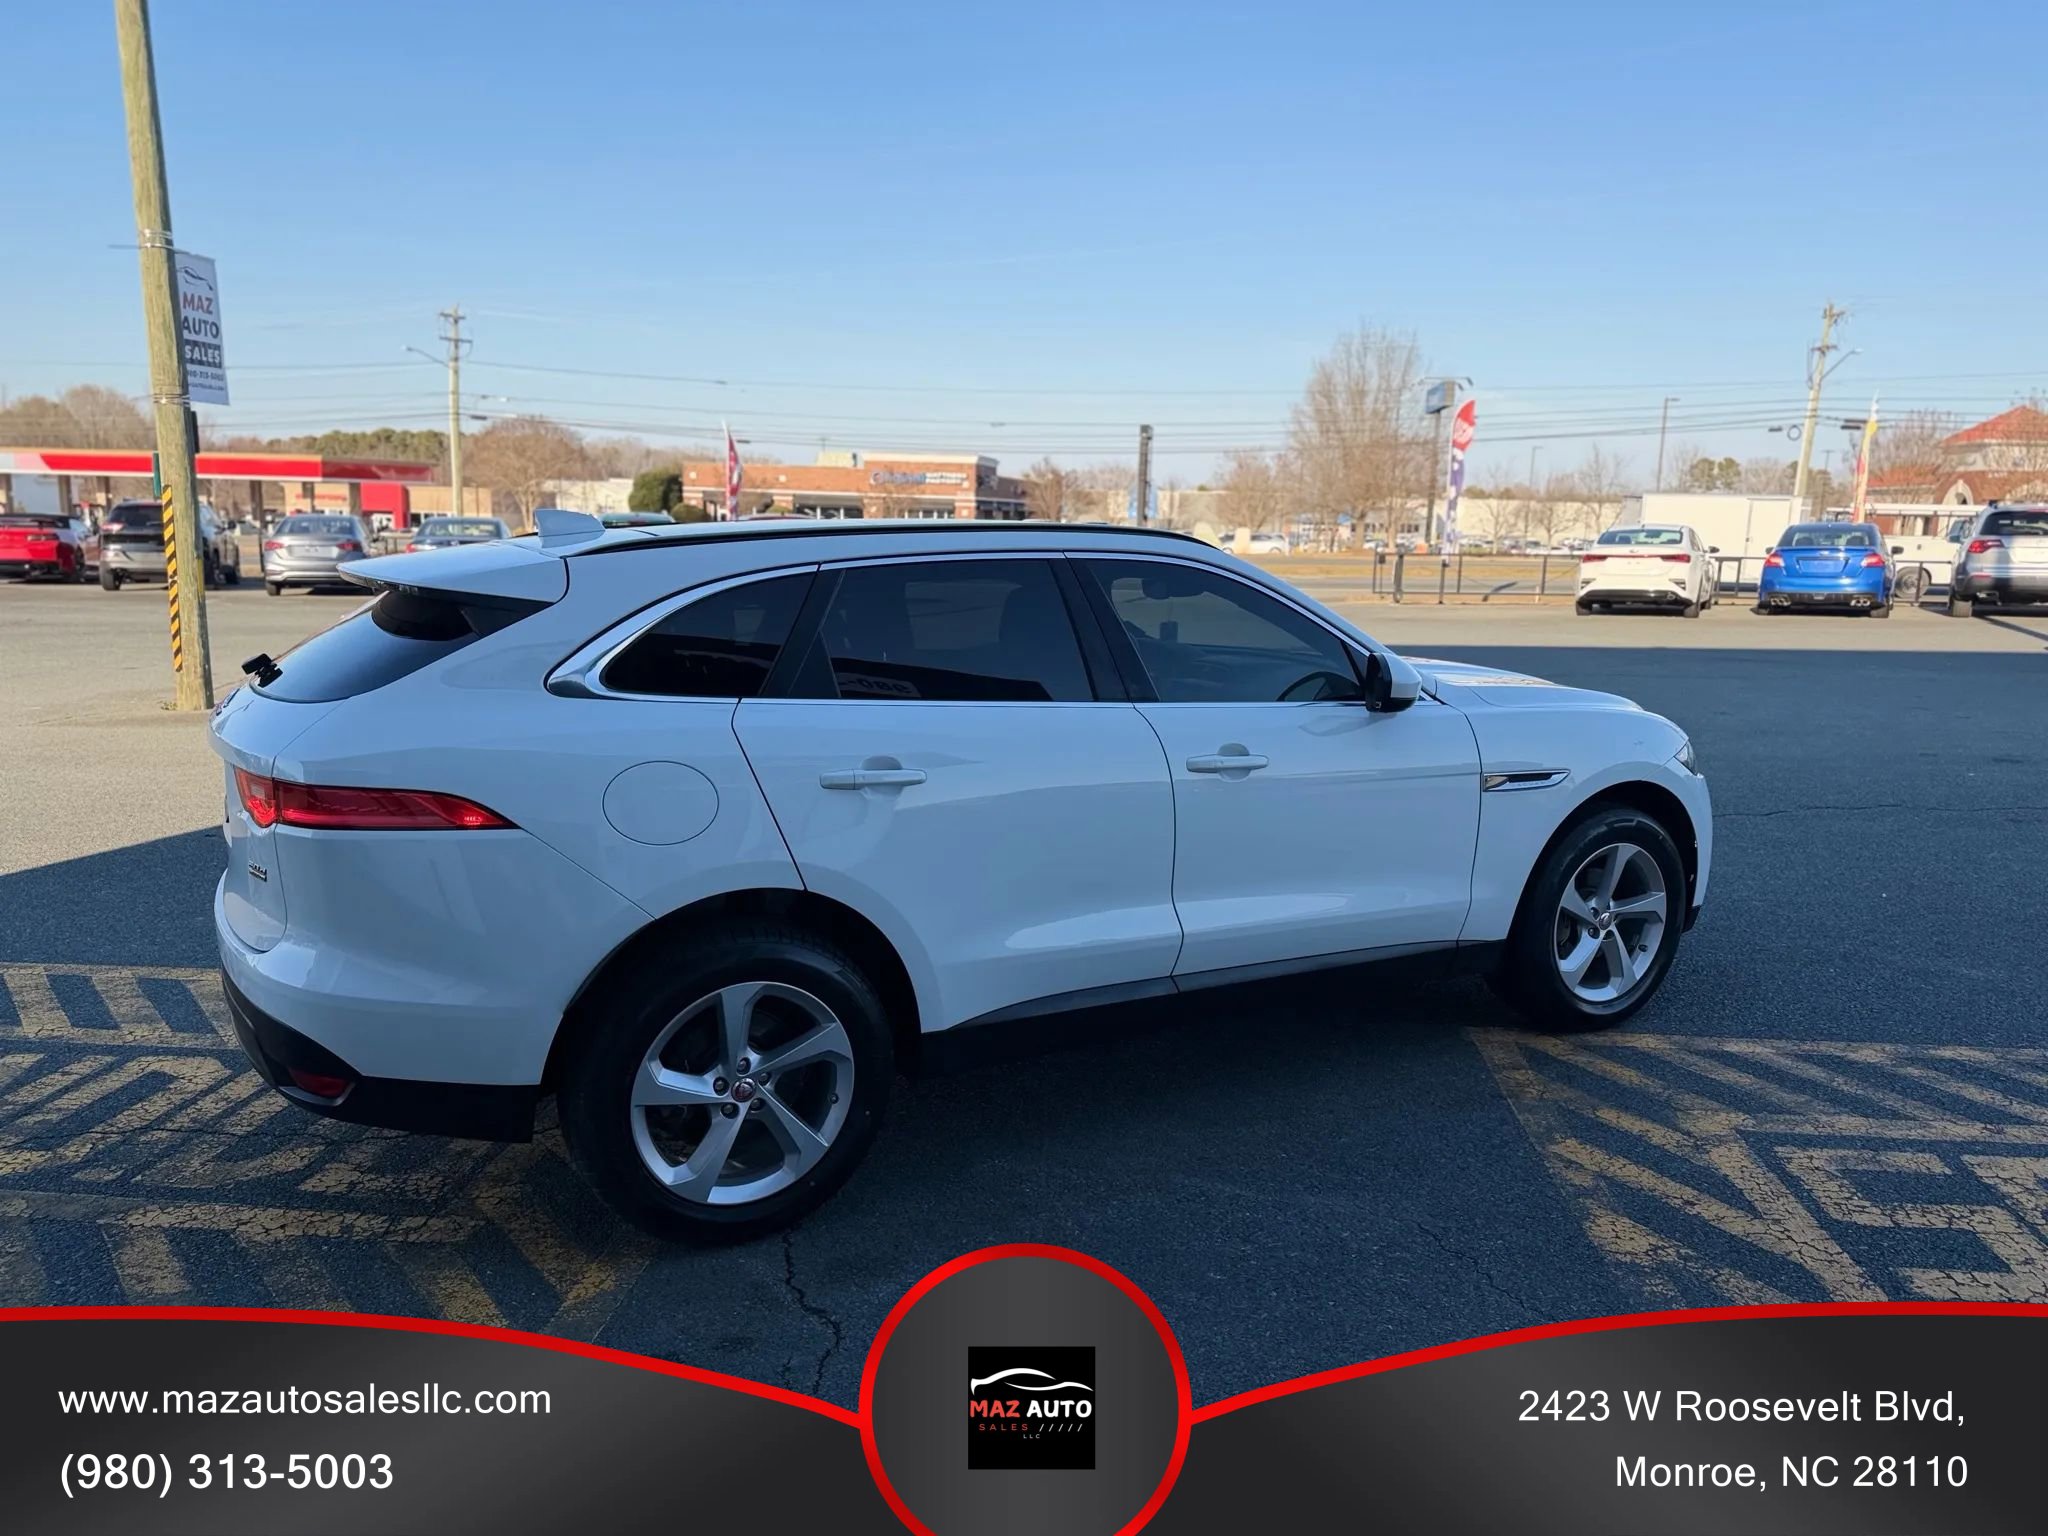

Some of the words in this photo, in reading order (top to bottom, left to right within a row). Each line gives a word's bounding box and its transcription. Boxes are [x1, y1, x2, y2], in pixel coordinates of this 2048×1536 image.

[182, 291, 213, 315] MAZ
[182, 315, 220, 339] AUTO
[184, 345, 221, 364] SALES
